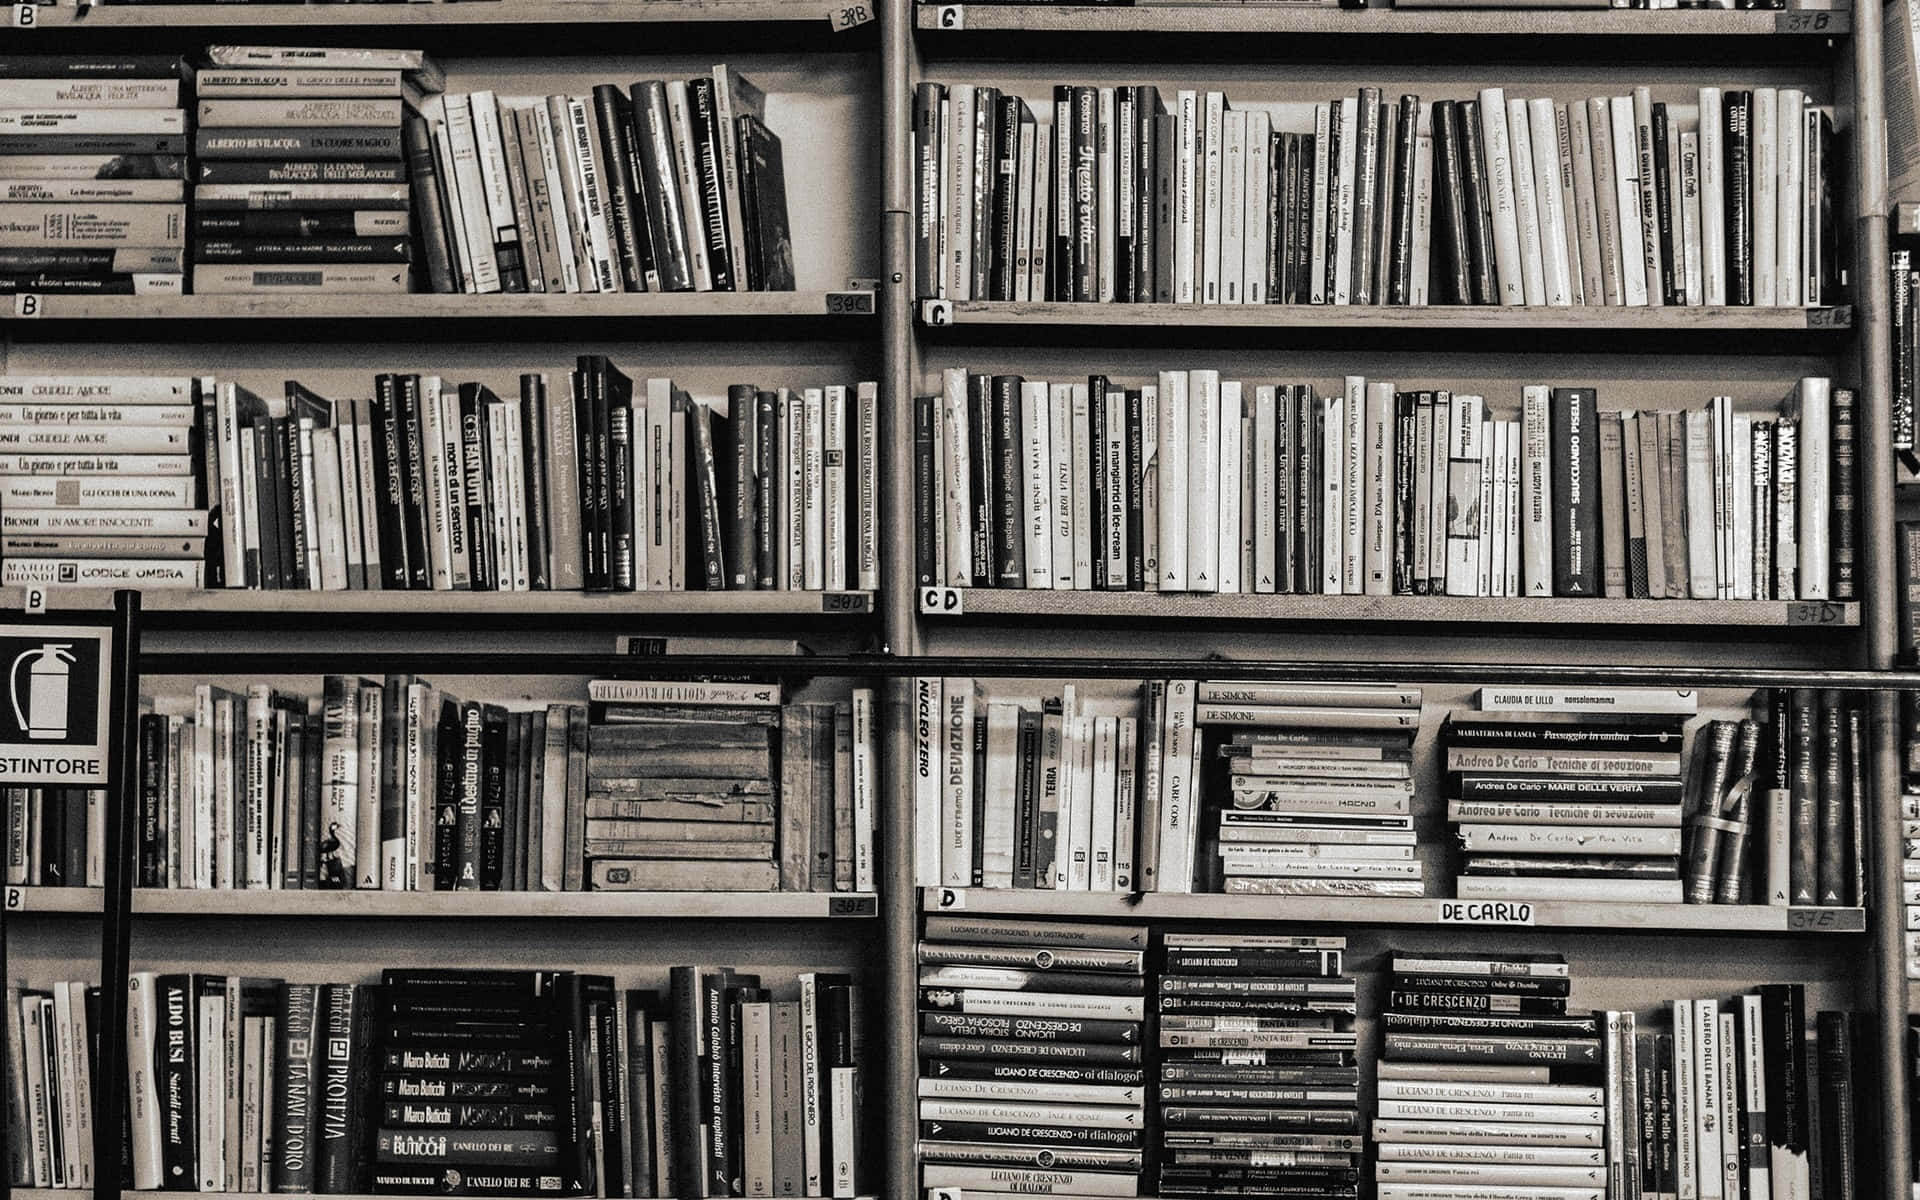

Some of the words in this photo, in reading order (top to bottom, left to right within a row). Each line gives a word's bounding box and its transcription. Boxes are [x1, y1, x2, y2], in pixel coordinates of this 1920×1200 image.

[20, 6, 34, 26] B
[839, 6, 867, 27] 38B
[207, 138, 246, 149] ALBERTO
[247, 139, 301, 151] BEVILACQUA
[1557, 110, 1569, 158] COSTANTINI
[1563, 162, 1572, 189] Veleno
[1683, 152, 1695, 178] Carmen
[1301, 167, 1311, 209] CASANOVA
[1301, 211, 1309, 222] DI
[1300, 223, 1308, 248] AMORI
[1300, 250, 1308, 265] TRE
[22, 295, 37, 315] B
[930, 305, 946, 326] C
[1002, 382, 1011, 417] RAFFAELE
[1570, 394, 1581, 434] PISELLI
[1003, 417, 1011, 440] CROVI
[1111, 440, 1122, 449] le
[288, 422, 301, 488] ALL'ITALIANO
[446, 442, 460, 477] morte
[464, 443, 480, 470] FAN
[1778, 427, 1796, 483] DEVIAZIONE
[1003, 448, 1014, 488] L'indagine
[1058, 462, 1068, 491] VINTI
[1110, 450, 1122, 503] mangiatrici
[1570, 436, 1581, 504] SBUCCIANDO
[450, 478, 462, 489] di
[465, 471, 482, 506] TUTTI
[291, 489, 302, 511] NON
[451, 490, 461, 504] un
[1004, 490, 1014, 498] di
[1005, 500, 1014, 514] via
[1059, 494, 1068, 515] EROI
[1111, 503, 1122, 513] di
[4, 517, 40, 527] BIONDI
[48, 517, 62, 527] UN
[64, 517, 92, 527] AMORE
[94, 517, 154, 527] INNOCENTE
[293, 512, 303, 532] FAR
[452, 505, 465, 554] senatore
[1059, 519, 1069, 538] GLI
[1003, 518, 1015, 550] Rapallo
[1112, 513, 1123, 561] ice-cream
[295, 533, 305, 569] SAPERE
[30, 593, 43, 611] B
[926, 590, 938, 607] C
[944, 590, 958, 610] D
[1207, 690, 1222, 701] DE
[1222, 690, 1257, 702] SIMONE
[1494, 694, 1522, 706] CLAUDIA
[1524, 695, 1534, 706] DE
[1535, 695, 1554, 706] LILLO
[919, 679, 930, 738] NUCLEO
[1206, 710, 1220, 721] DE
[1221, 711, 1256, 722] SIMONE
[463, 708, 482, 748] pugno
[462, 748, 477, 760] in
[919, 739, 930, 778] ZERO
[1455, 753, 1494, 768] Andrea
[1496, 754, 1511, 769] De
[1512, 755, 1538, 769] Carlo
[1546, 756, 1588, 771] Tecniche
[1590, 757, 1600, 771] di
[1603, 758, 1655, 773] seduzione
[460, 761, 477, 804] destino
[1045, 766, 1057, 798] TERRA
[1170, 775, 1181, 802] CARE
[1474, 781, 1505, 791] Andrea
[1506, 782, 1518, 791] De
[1519, 782, 1542, 792] Carlo
[1548, 783, 1576, 793] MARE
[1578, 784, 1608, 793] DELLE
[1609, 783, 1644, 794] VERITÀ
[1169, 804, 1180, 831] COSE
[1457, 802, 1496, 817] Andrea
[1497, 803, 1512, 818] De
[1513, 804, 1541, 818] Carlo
[1549, 805, 1589, 819] Tecniche
[1592, 806, 1602, 819] di
[8, 889, 20, 909] B
[941, 889, 955, 907] D
[1442, 903, 1466, 922] DE
[1467, 903, 1531, 922] CARLO
[167, 987, 184, 1026] ALDO
[709, 988, 721, 1025] Antonio
[1405, 994, 1420, 1007] DE
[1423, 994, 1489, 1009] CRESCENZO
[934, 1015, 971, 1026] GRECA
[971, 1017, 1011, 1028] FILOSOFIA
[1015, 1020, 1069, 1032] CRESCENZO
[1069, 1022, 1083, 1033] DE
[1702, 1005, 1714, 1045] L'ALBERO
[951, 1026, 977, 1037] DELLA
[984, 1027, 1009, 1038] STORIA
[1015, 1029, 1056, 1040] LUCIANO
[168, 1029, 184, 1063] BUSI
[710, 1026, 722, 1061] Calabrò
[403, 1051, 425, 1069] Marco
[425, 1051, 450, 1069] Buticchi
[1703, 1047, 1714, 1071] DELLE
[711, 1062, 723, 1105] Intervista
[994, 1067, 1027, 1078] LUCIANO
[1028, 1068, 1039, 1078] DE
[1040, 1068, 1081, 1079] CRESCENZO
[1084, 1069, 1096, 1080] oi
[1096, 1070, 1141, 1083] dialogoi
[169, 1070, 182, 1108] Suicidi
[398, 1079, 420, 1096] Marco
[420, 1080, 446, 1096] Buticchi
[1703, 1073, 1715, 1109] BANANE
[712, 1106, 723, 1115] ai
[1660, 1098, 1671, 1110] de
[403, 1106, 426, 1124] Marco
[426, 1106, 452, 1124] Buticchi
[987, 1127, 1021, 1138] LUCIANO
[1021, 1128, 1032, 1138] DE
[1032, 1128, 1074, 1139] CRESCENZO
[1077, 1128, 1089, 1140] oi
[1090, 1129, 1135, 1143] dialogoi
[1378, 1126, 1387, 1134] 2
[1660, 1111, 1673, 1140] Mello
[394, 1134, 447, 1143] MARCO
[712, 1116, 724, 1159] capitalisti
[393, 1142, 447, 1157] BUTICCHI
[488, 1144, 503, 1153] DEI
[504, 1144, 514, 1153] RE
[991, 1170, 1021, 1182] LUCIANO
[1021, 1172, 1033, 1183] DE
[1033, 1173, 1073, 1185] CRESCENZO
[1009, 1182, 1019, 1193] OI
[1019, 1182, 1053, 1194] DIALOGOI
